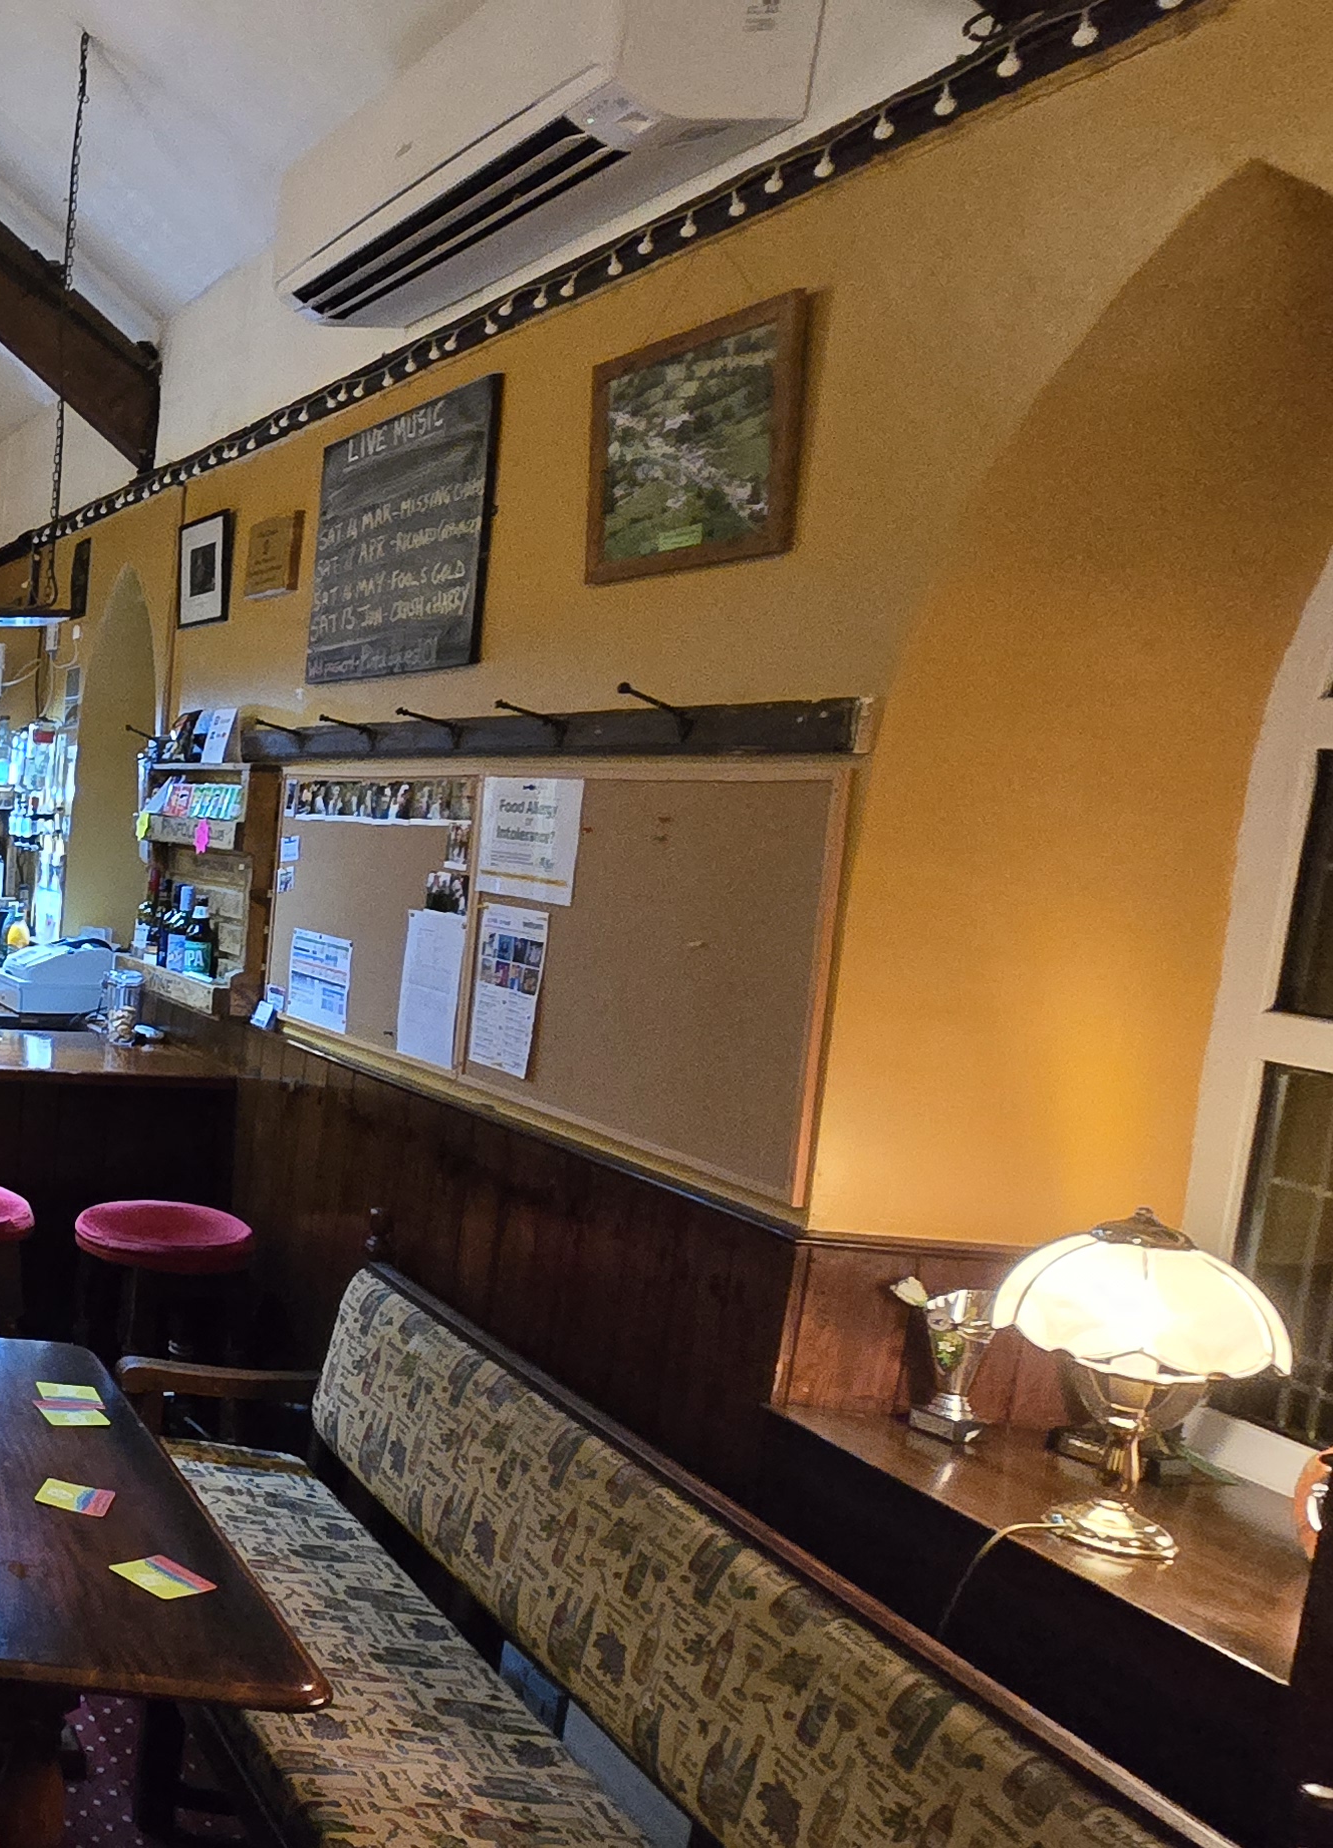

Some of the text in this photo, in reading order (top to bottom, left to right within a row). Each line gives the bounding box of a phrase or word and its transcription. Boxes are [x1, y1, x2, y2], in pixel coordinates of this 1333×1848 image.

[346, 400, 447, 463] LIVE MUSIC
[318, 522, 344, 552] SAT
[361, 504, 392, 531] MAR
[400, 485, 451, 519] MISSING
[358, 535, 387, 565] APR
[355, 571, 385, 599] MAY
[310, 607, 339, 643] SAT
[341, 605, 356, 630] 13
[499, 799, 559, 819] Food Allergy
[184, 950, 205, 967] IPA
